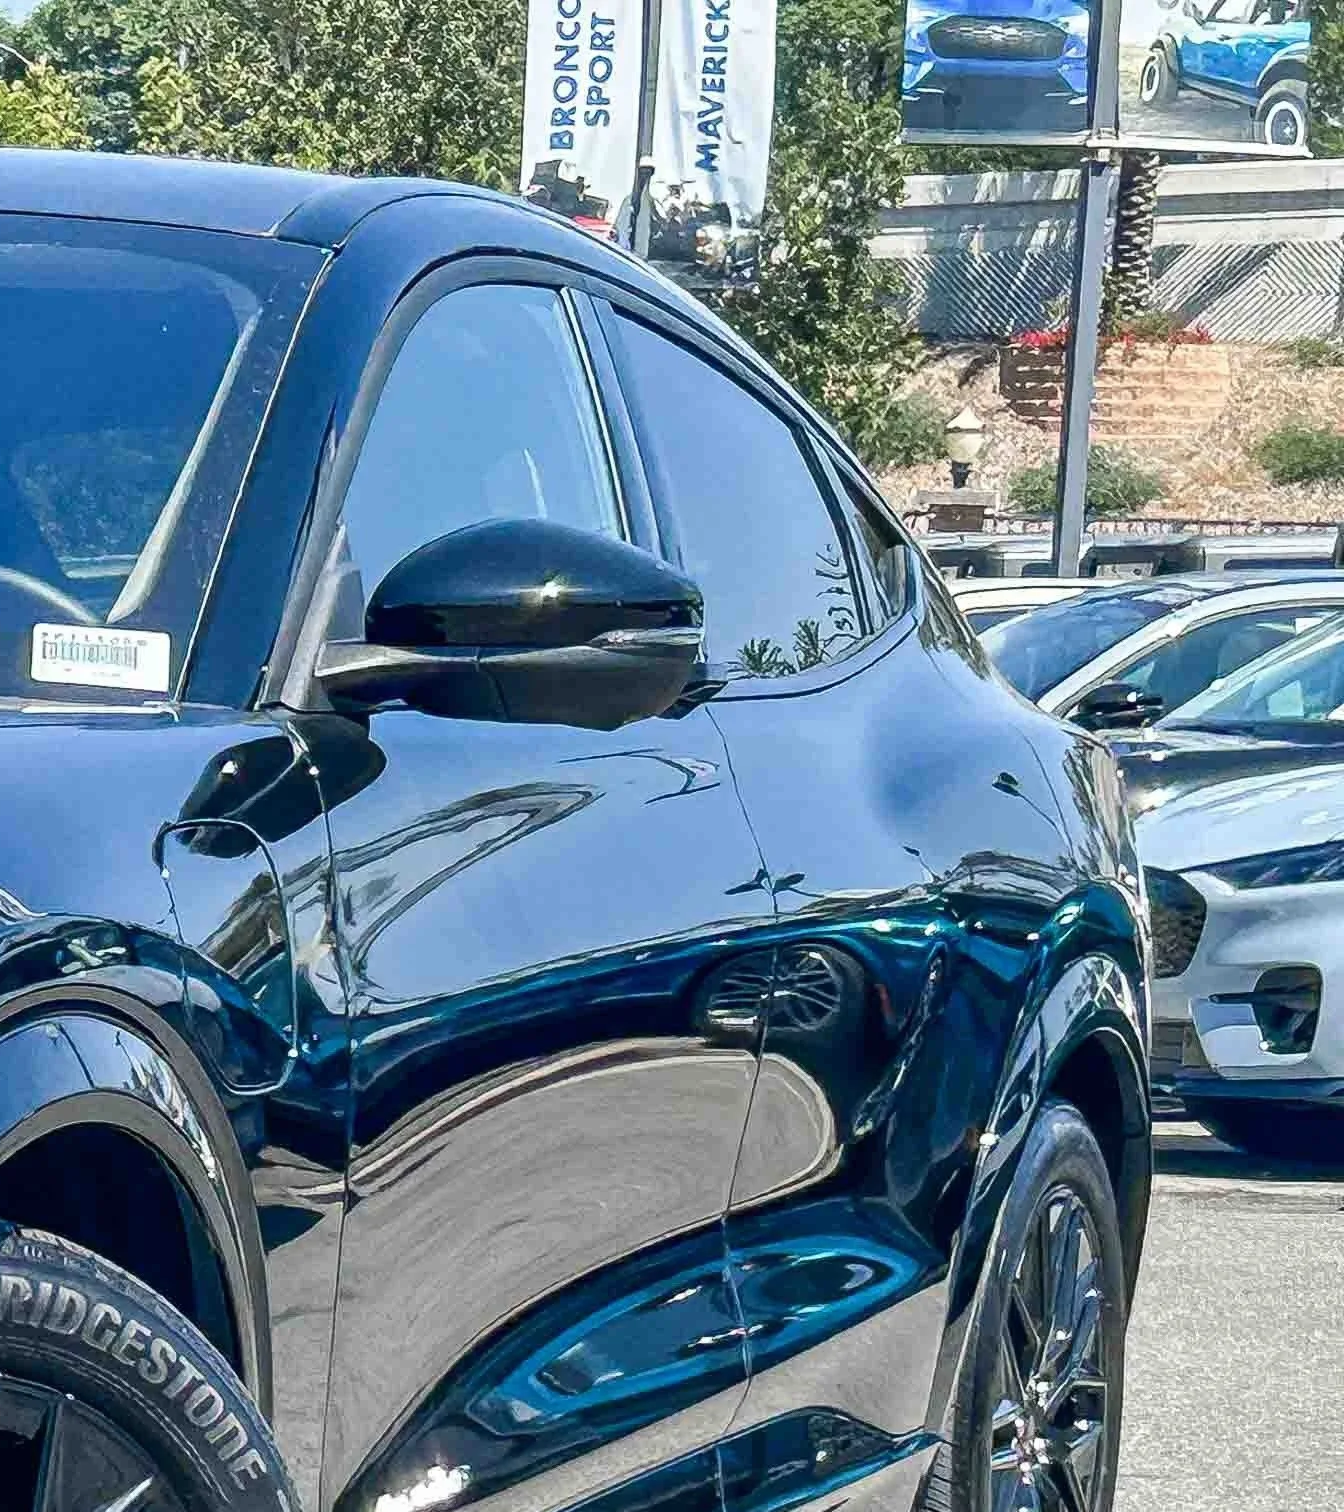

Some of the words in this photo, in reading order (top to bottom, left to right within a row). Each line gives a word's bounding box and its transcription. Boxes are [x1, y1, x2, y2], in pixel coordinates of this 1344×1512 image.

[550, 0, 582, 150] BRONCO
[584, 12, 615, 127] SPORT
[695, 0, 730, 173] MAVERICK
